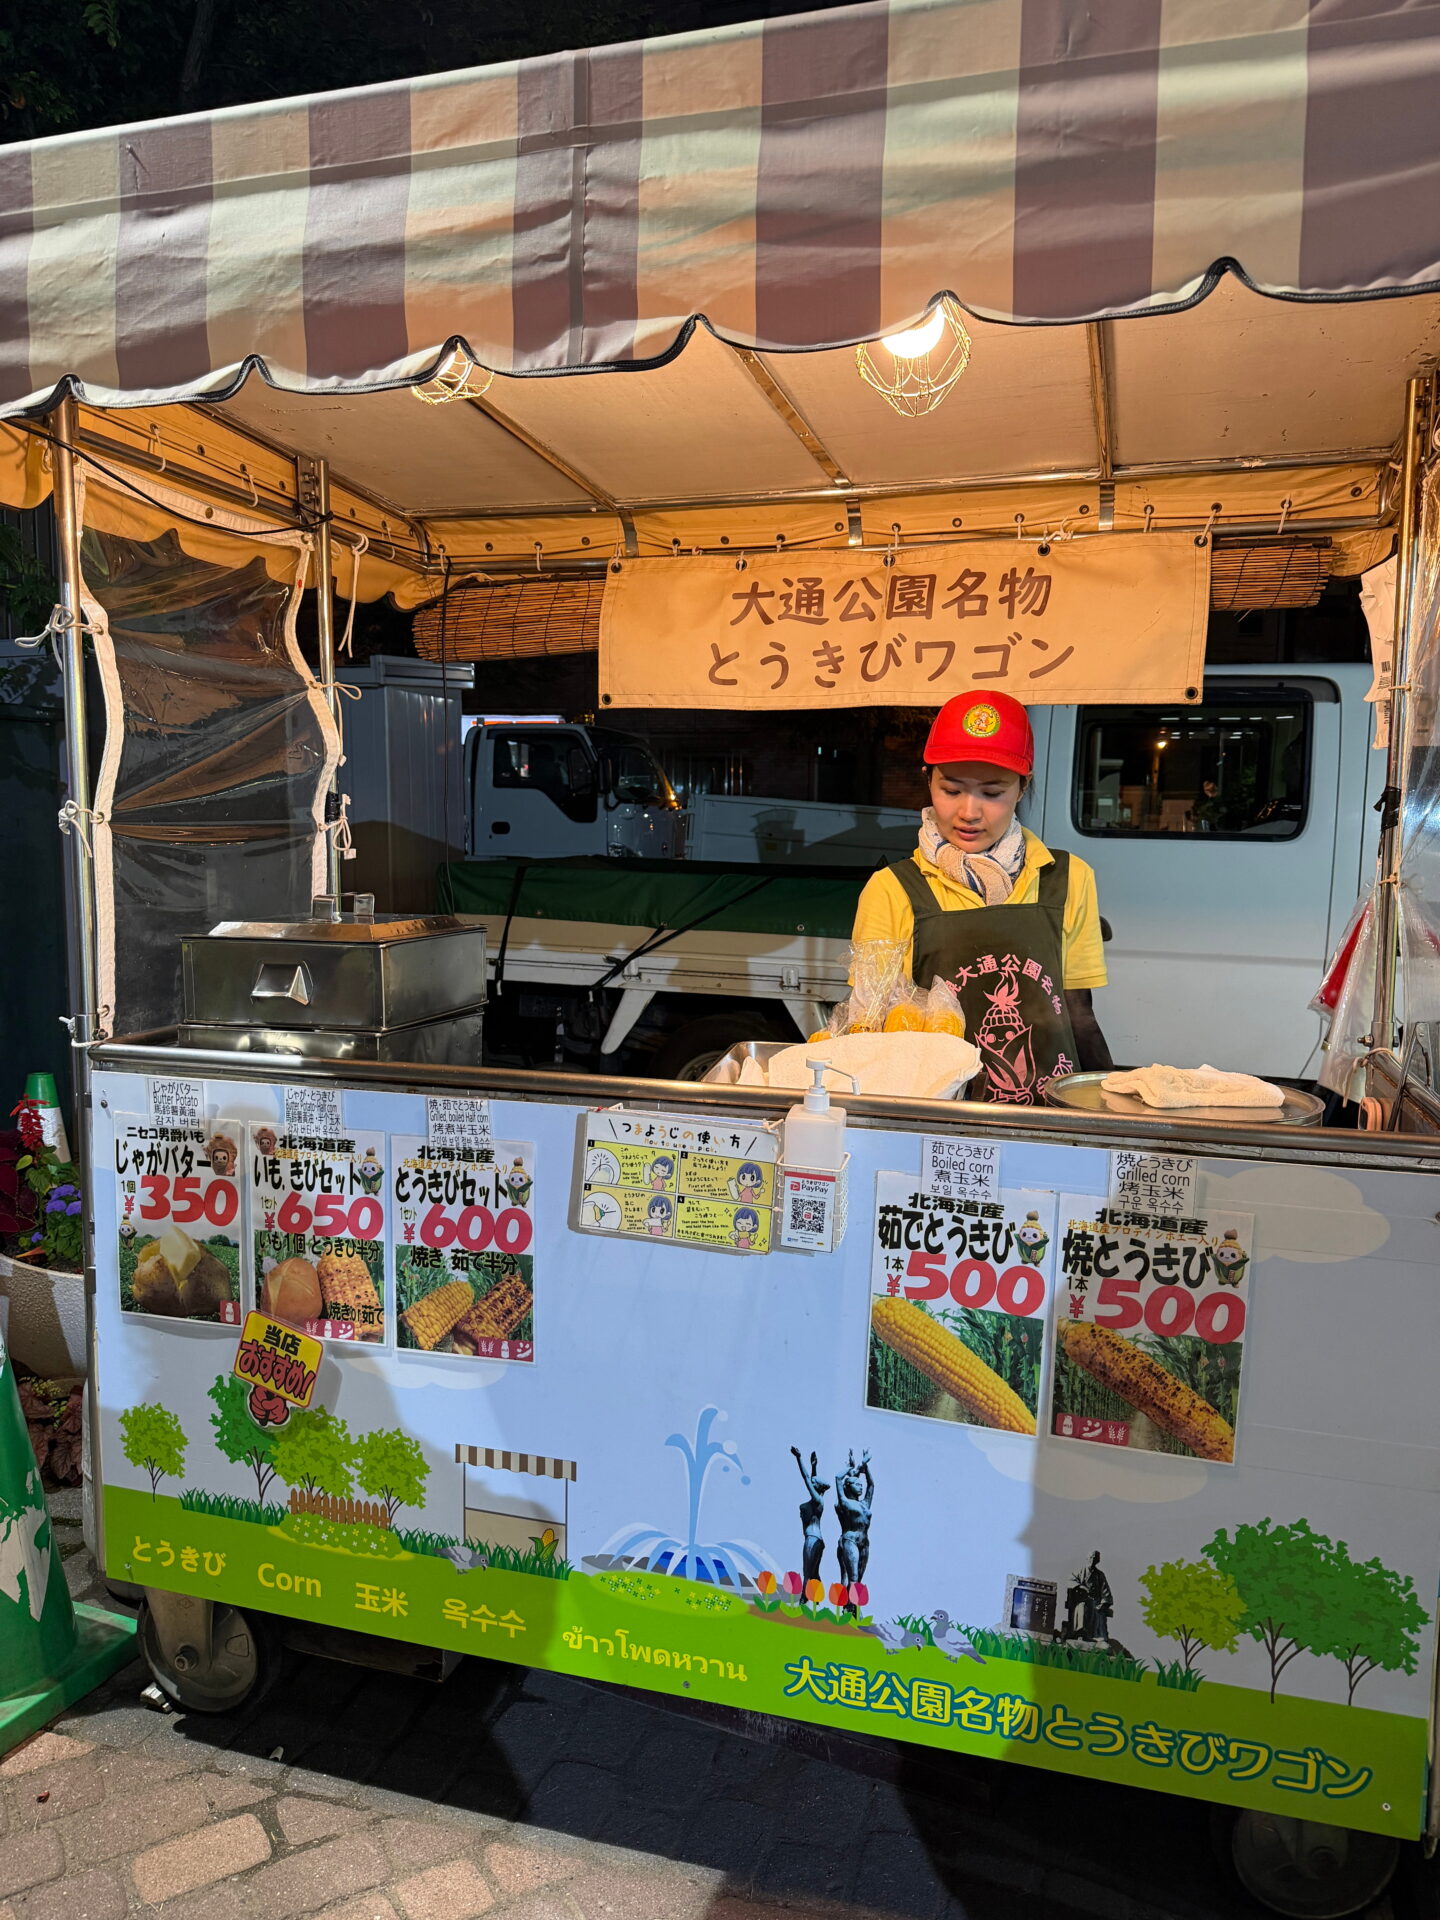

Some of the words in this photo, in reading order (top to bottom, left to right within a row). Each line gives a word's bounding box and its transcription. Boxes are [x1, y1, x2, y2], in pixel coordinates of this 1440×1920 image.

[729, 567, 1052, 627] 大通公園名物
[707, 632, 1075, 691] とうきびワゴン
[153, 1080, 199, 1095] じゃがバター
[153, 1092, 173, 1105] Butter
[176, 1093, 198, 1107] Potato
[155, 1115, 175, 1126] 감자
[179, 1118, 200, 1128] 버터
[433, 1123, 491, 1136] 烤煮半玉米
[127, 1127, 205, 1143] ニセコ男爵いも
[279, 1135, 355, 1153] 北海道産
[621, 1121, 741, 1149] つまようじの使い方
[116, 1139, 211, 1178] じゃがバター
[417, 1145, 495, 1163] 北海道産
[931, 1141, 994, 1160] 茹でとうきび
[403, 1158, 508, 1174] 北海道産プロテインホエー入り
[932, 1156, 965, 1171] Boiled
[969, 1161, 994, 1174] corn
[1116, 1152, 1193, 1173] 焼とうきび
[121, 1180, 136, 1193] 1個
[935, 1169, 990, 1187] 煮玉米
[1116, 1167, 1157, 1183] Grilled
[1162, 1173, 1190, 1186] corn
[395, 1167, 507, 1208] とうきびセット
[801, 1184, 829, 1194] PayPay
[930, 1184, 952, 1196] 보일
[957, 1186, 992, 1200] 옥수수
[1119, 1181, 1185, 1200] 烤玉米
[908, 1192, 1005, 1220] 北海道産
[1118, 1194, 1142, 1210] 구운
[1146, 1197, 1183, 1215] 옥수수
[1096, 1207, 1208, 1236] 北海道産
[878, 1204, 1016, 1264] 茹でとうきび
[1067, 1219, 1219, 1247] 北海道産プロテインホエー入り
[884, 1256, 904, 1272] 1本
[1062, 1229, 1213, 1288] 焼とうきび
[1066, 1277, 1088, 1292] 1本
[263, 1324, 302, 1356] 当店
[131, 1534, 226, 1577] とうきび
[258, 1563, 323, 1599] Corn
[355, 1583, 409, 1618] 玉米
[441, 1598, 528, 1639] 옥수수
[562, 1625, 748, 1683] ข้าวโพดหวาน
[783, 1656, 1373, 1799] 大通公園名物とうきびワゴン
